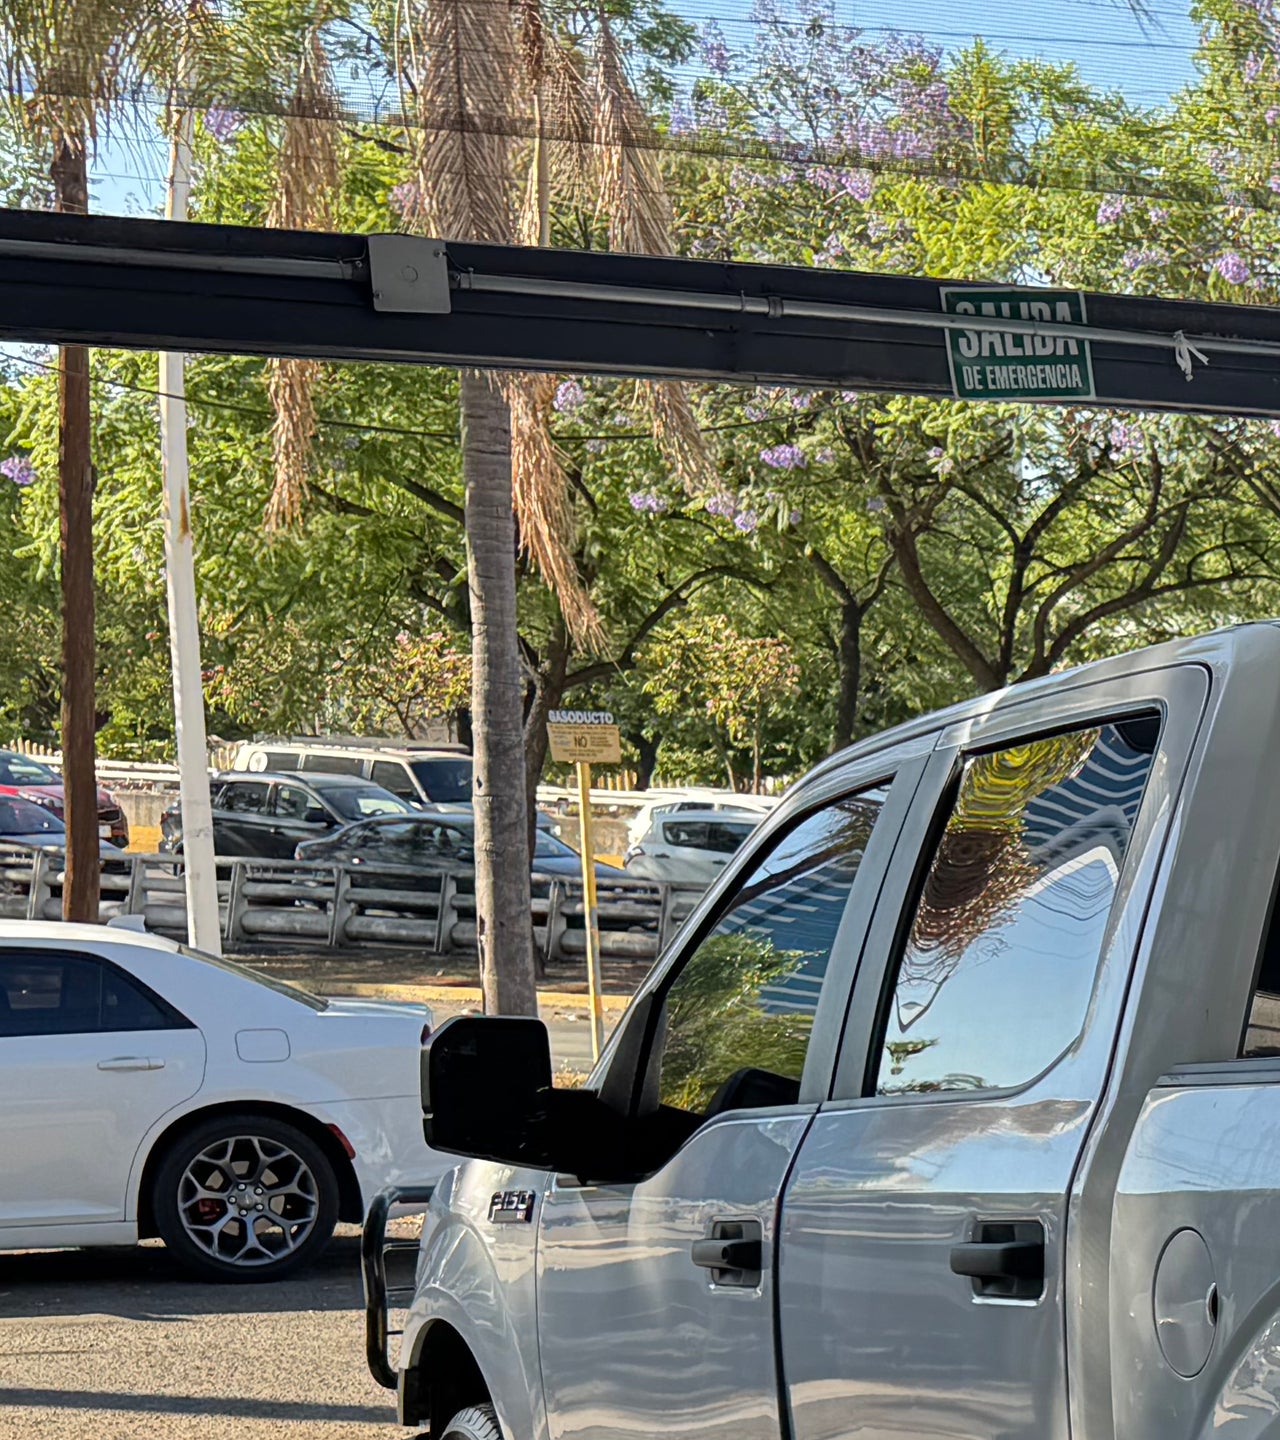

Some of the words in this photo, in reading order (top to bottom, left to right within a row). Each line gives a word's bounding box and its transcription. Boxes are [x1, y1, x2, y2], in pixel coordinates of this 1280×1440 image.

[955, 301, 1079, 358] SALIDA
[962, 364, 984, 390] DE
[986, 363, 1083, 390] EMERGENCIA
